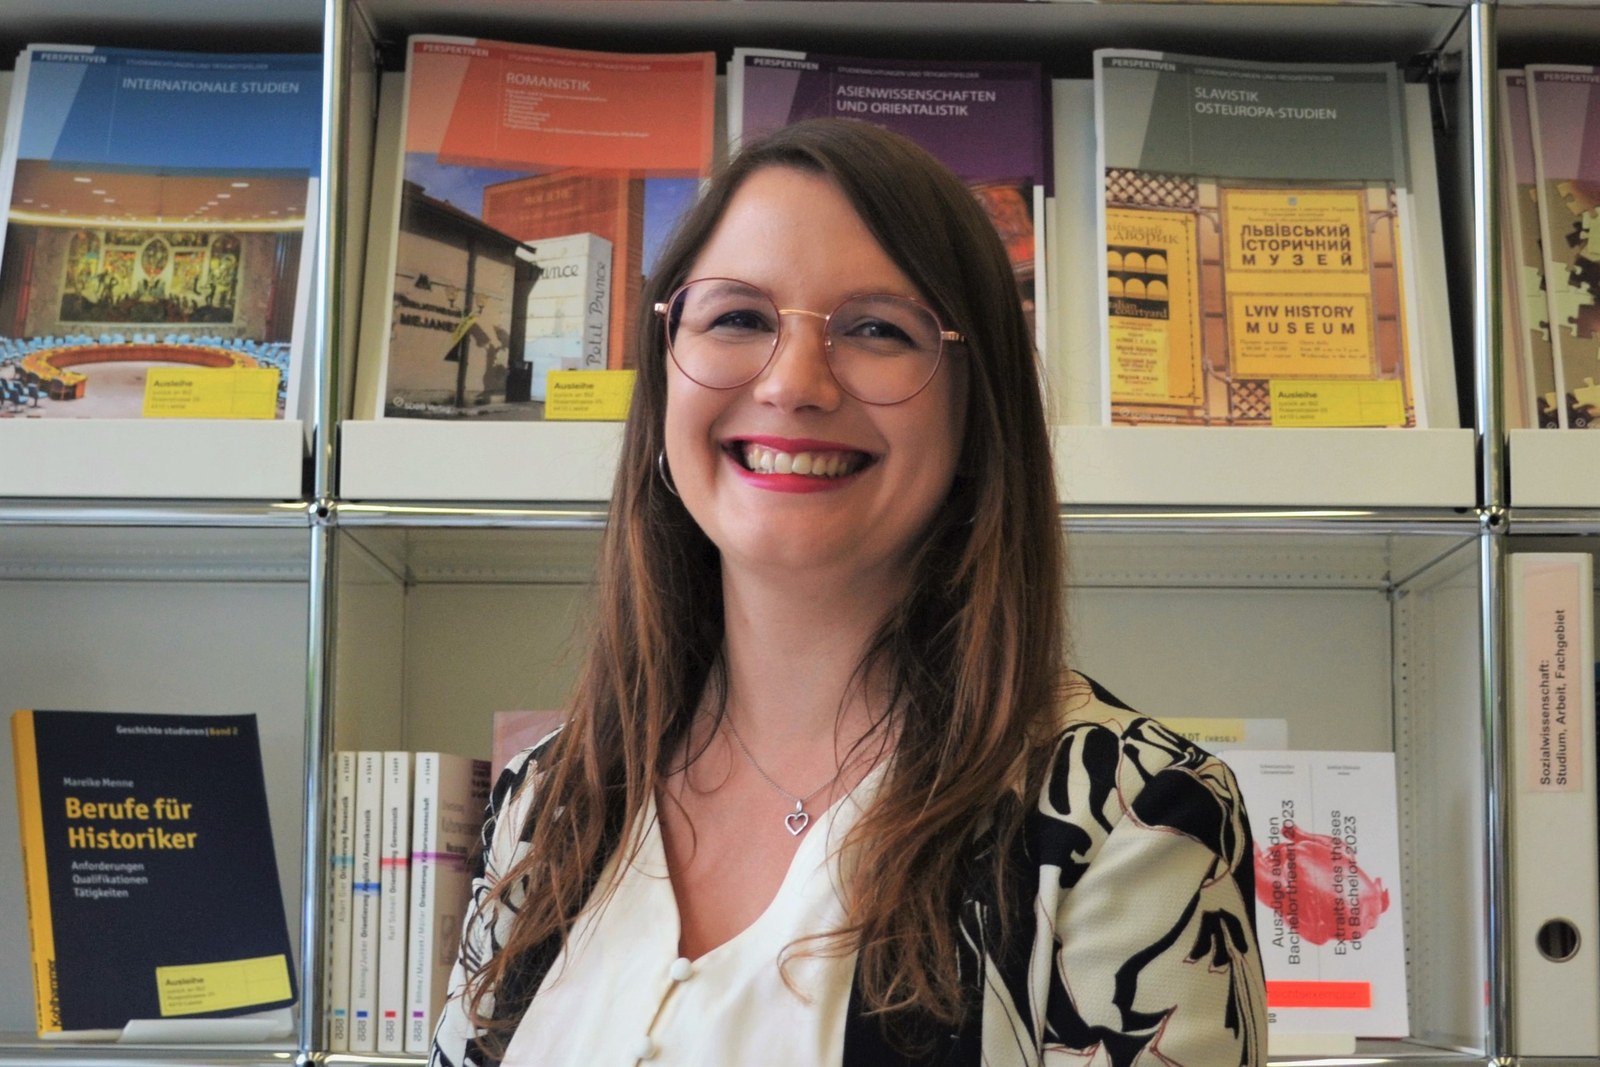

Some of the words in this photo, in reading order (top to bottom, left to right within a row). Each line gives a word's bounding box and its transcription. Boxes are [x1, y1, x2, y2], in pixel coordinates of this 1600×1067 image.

[41, 53, 107, 63] PERSPEKTIVEN
[754, 58, 819, 71] PERSPEKTIVEN
[1111, 58, 1176, 72] PERSPEKTIVEN
[122, 78, 237, 93] INTERNATIONALE
[241, 82, 299, 93] STUDIEN
[506, 72, 590, 91] ROMANISTIK
[837, 85, 996, 102] ASIENWISSENSCHAFTEN
[1195, 87, 1259, 102] SLAVISTIK
[837, 100, 868, 113] UND
[871, 103, 969, 116] ORIENTALISTIK
[1195, 102, 1337, 119] OSTEUROPA-STUDIEN
[1241, 237, 1352, 251] ІСТОРИЧНИЙ
[1245, 305, 1279, 317] LVIV
[1284, 305, 1354, 318] HISTORY
[1246, 322, 1355, 335] MUSEUM
[1278, 391, 1318, 399] Ausleihe
[1554, 609, 1568, 680] Fachgebiet
[1555, 683, 1568, 725] Arbeit,
[1538, 660, 1551, 785] Sozialwissenschaft:
[1556, 728, 1568, 785] Studium,
[63, 777, 101, 787] Mareike
[103, 778, 134, 788] Menne
[65, 797, 150, 820] Berufe
[154, 797, 193, 820] für
[341, 796, 349, 834] Romanistik
[1282, 799, 1296, 839] 2023
[68, 826, 198, 849] Historiker
[390, 807, 398, 848] Germanistik
[421, 798, 429, 863] Kulturwissenschaft
[1268, 817, 1281, 845] den
[1344, 816, 1357, 855] 2023
[72, 861, 145, 873] Anforderungen
[339, 837, 349, 880] Orientierung
[1270, 850, 1281, 876] aus
[72, 874, 149, 885] Qualifikationen
[389, 851, 398, 893] Orientierung
[1331, 866, 1344, 894] des
[73, 887, 129, 900] Tätigkeiten
[419, 865, 428, 908] Orientierung
[1347, 859, 1361, 926] Bachelor
[1270, 880, 1285, 948] Auszüge
[1285, 842, 1300, 965] Bachelorthesen
[361, 895, 370, 938] Orientierung
[1332, 897, 1347, 955] Extraits
[1350, 930, 1362, 951] de
